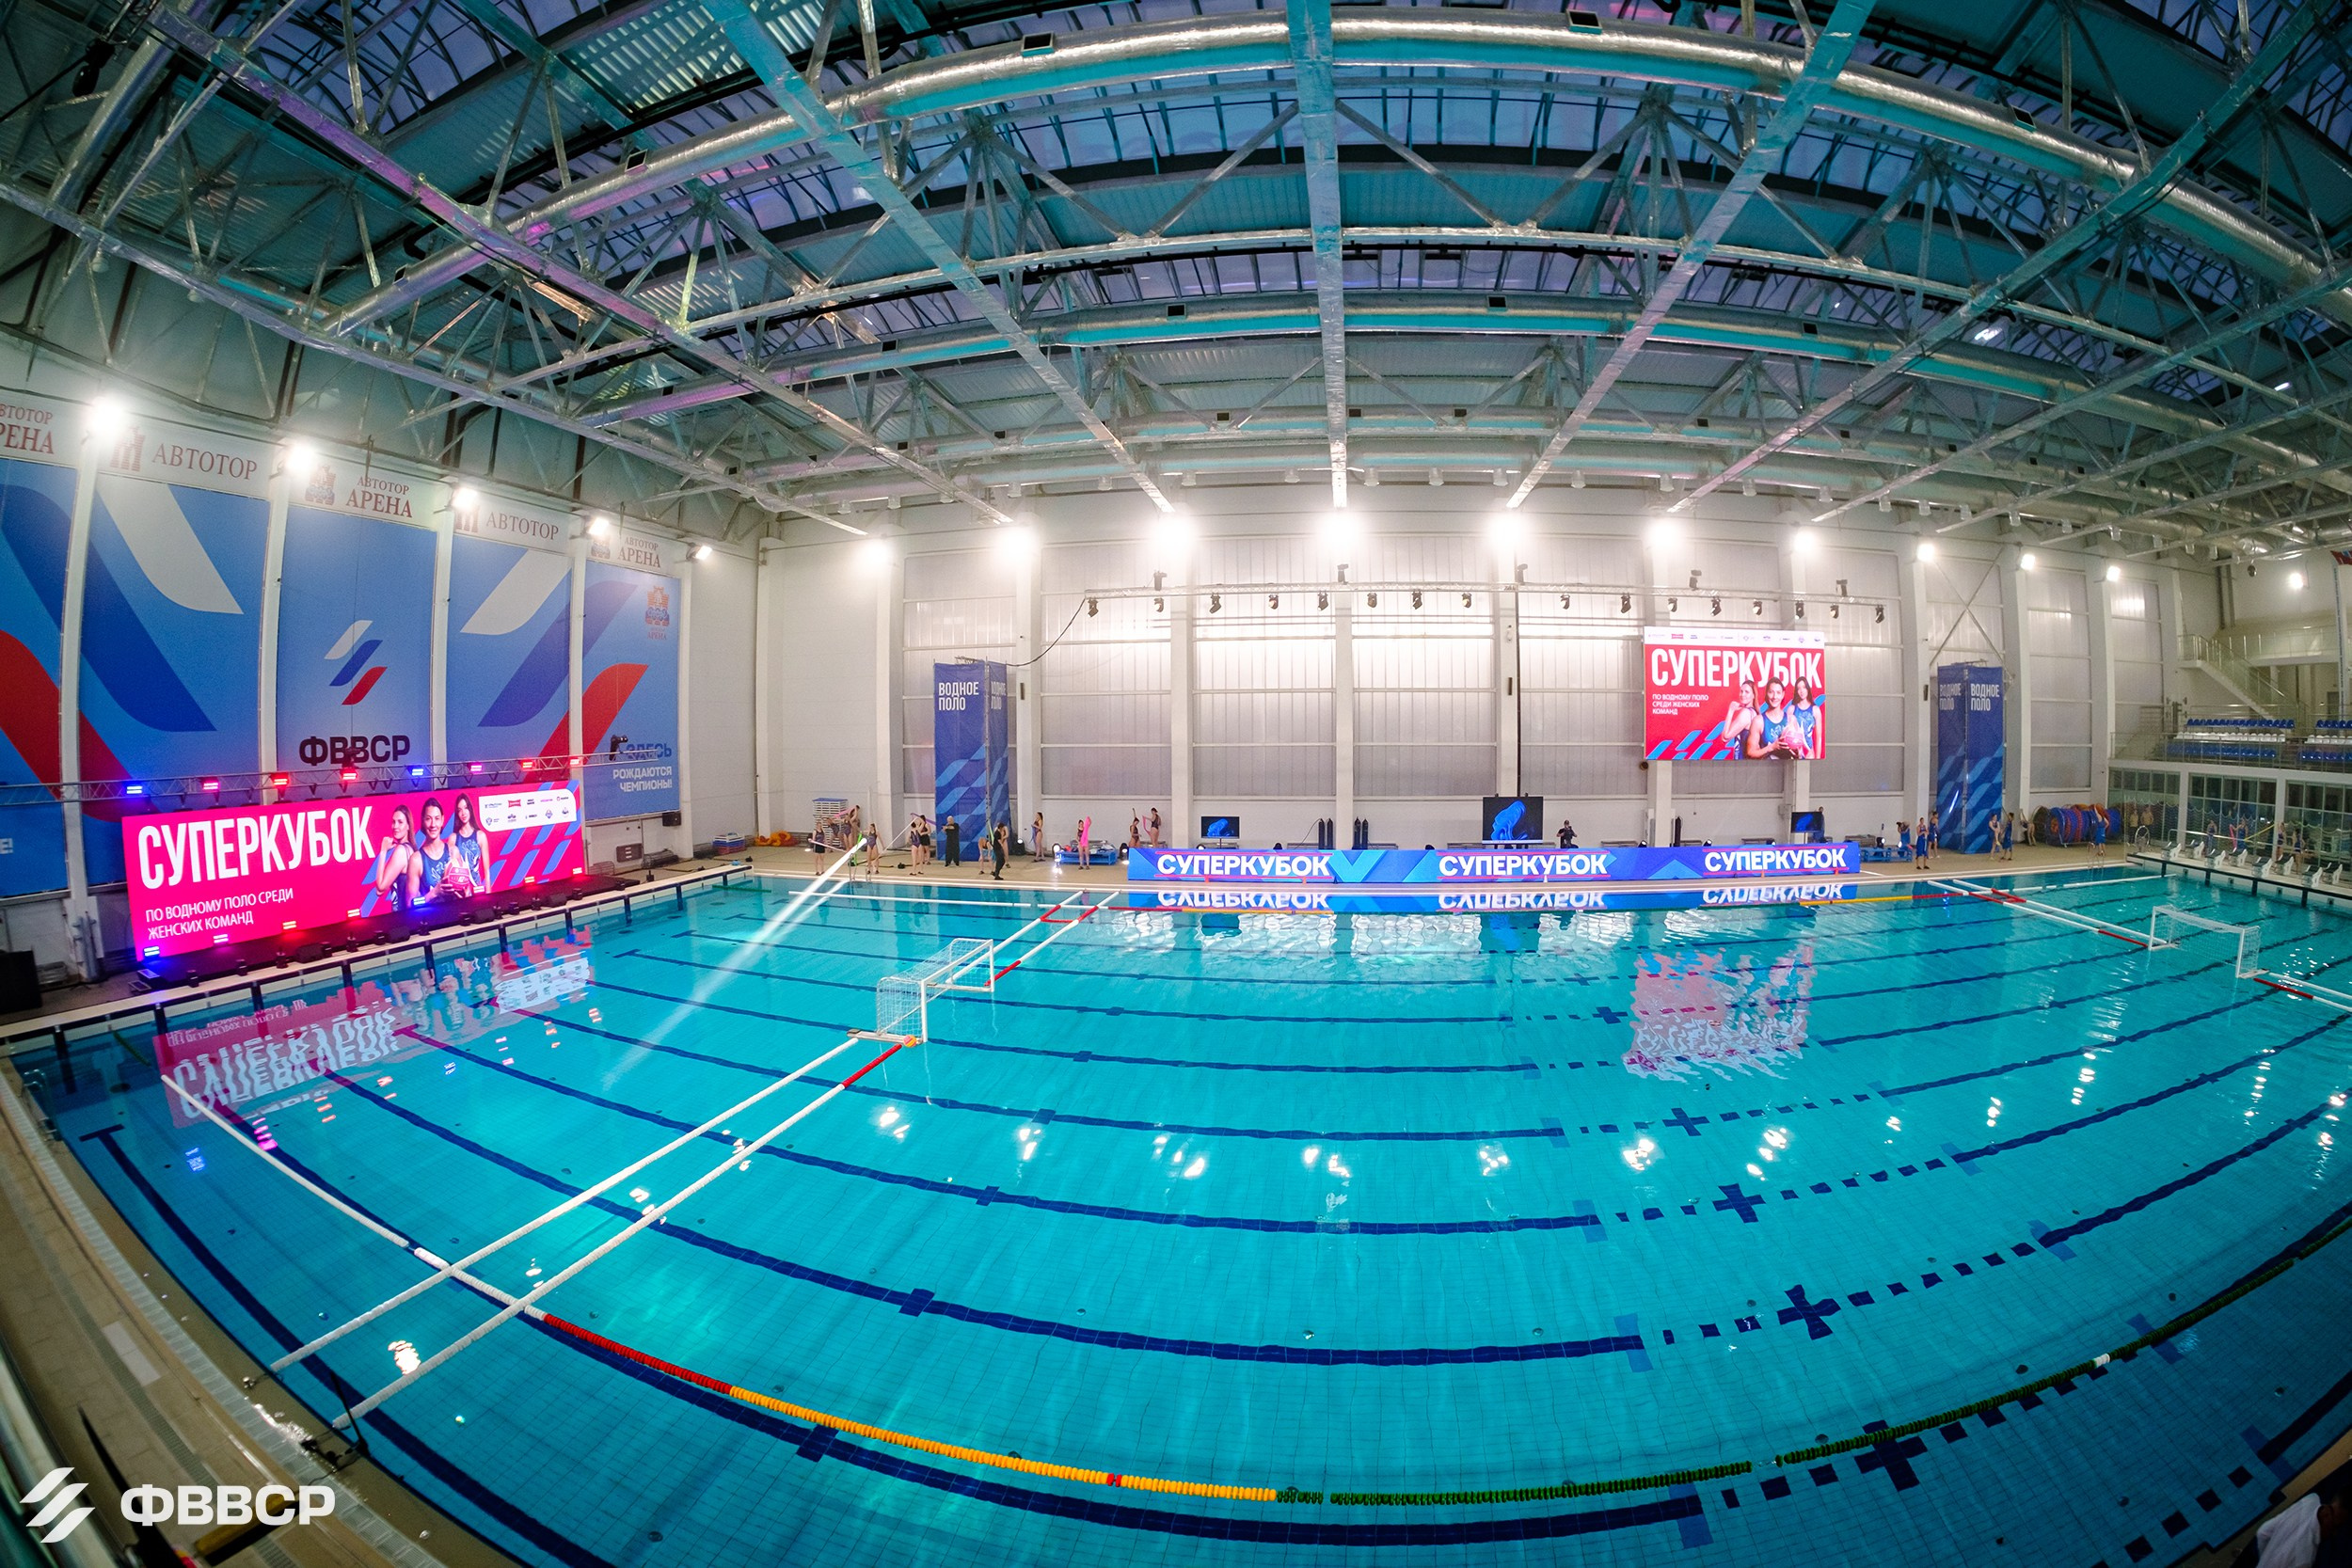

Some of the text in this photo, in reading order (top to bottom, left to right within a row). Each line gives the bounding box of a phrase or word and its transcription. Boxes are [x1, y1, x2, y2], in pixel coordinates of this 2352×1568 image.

[152, 443, 258, 481] АВТОТОР
[358, 476, 410, 496] АВТОТОР
[346, 489, 412, 518] АРЕНА
[485, 511, 559, 541] АВТОТОР
[625, 536, 659, 550] АВТОТОР
[617, 547, 660, 568] АРЕНА
[1651, 648, 1822, 689] СУПЕРКУБОК
[938, 681, 979, 698] ВОДНОЕ
[1970, 683, 2000, 698] ВОДНОЕ
[938, 697, 966, 711] ПОЛО
[1652, 701, 1672, 709] СРЕДИ
[1970, 697, 1992, 711] ПОЛО
[298, 736, 411, 767] ФВВСР
[612, 766, 673, 780] РОЖДАЮТСЯ
[619, 779, 673, 793] ЧЕМПИОНЫ!
[137, 805, 375, 890] СУПЕРКУБОК
[1157, 854, 1330, 876] СУПЕРКУБОК
[1438, 854, 1607, 876] СУПЕРКУБОК
[1705, 849, 1847, 871] СУПЕРКУБОК
[145, 887, 294, 923] ПО ВОДНОМУ ПОЛО СРЕДИ
[147, 911, 254, 941] ЖЕНСКИХ КОМАНД
